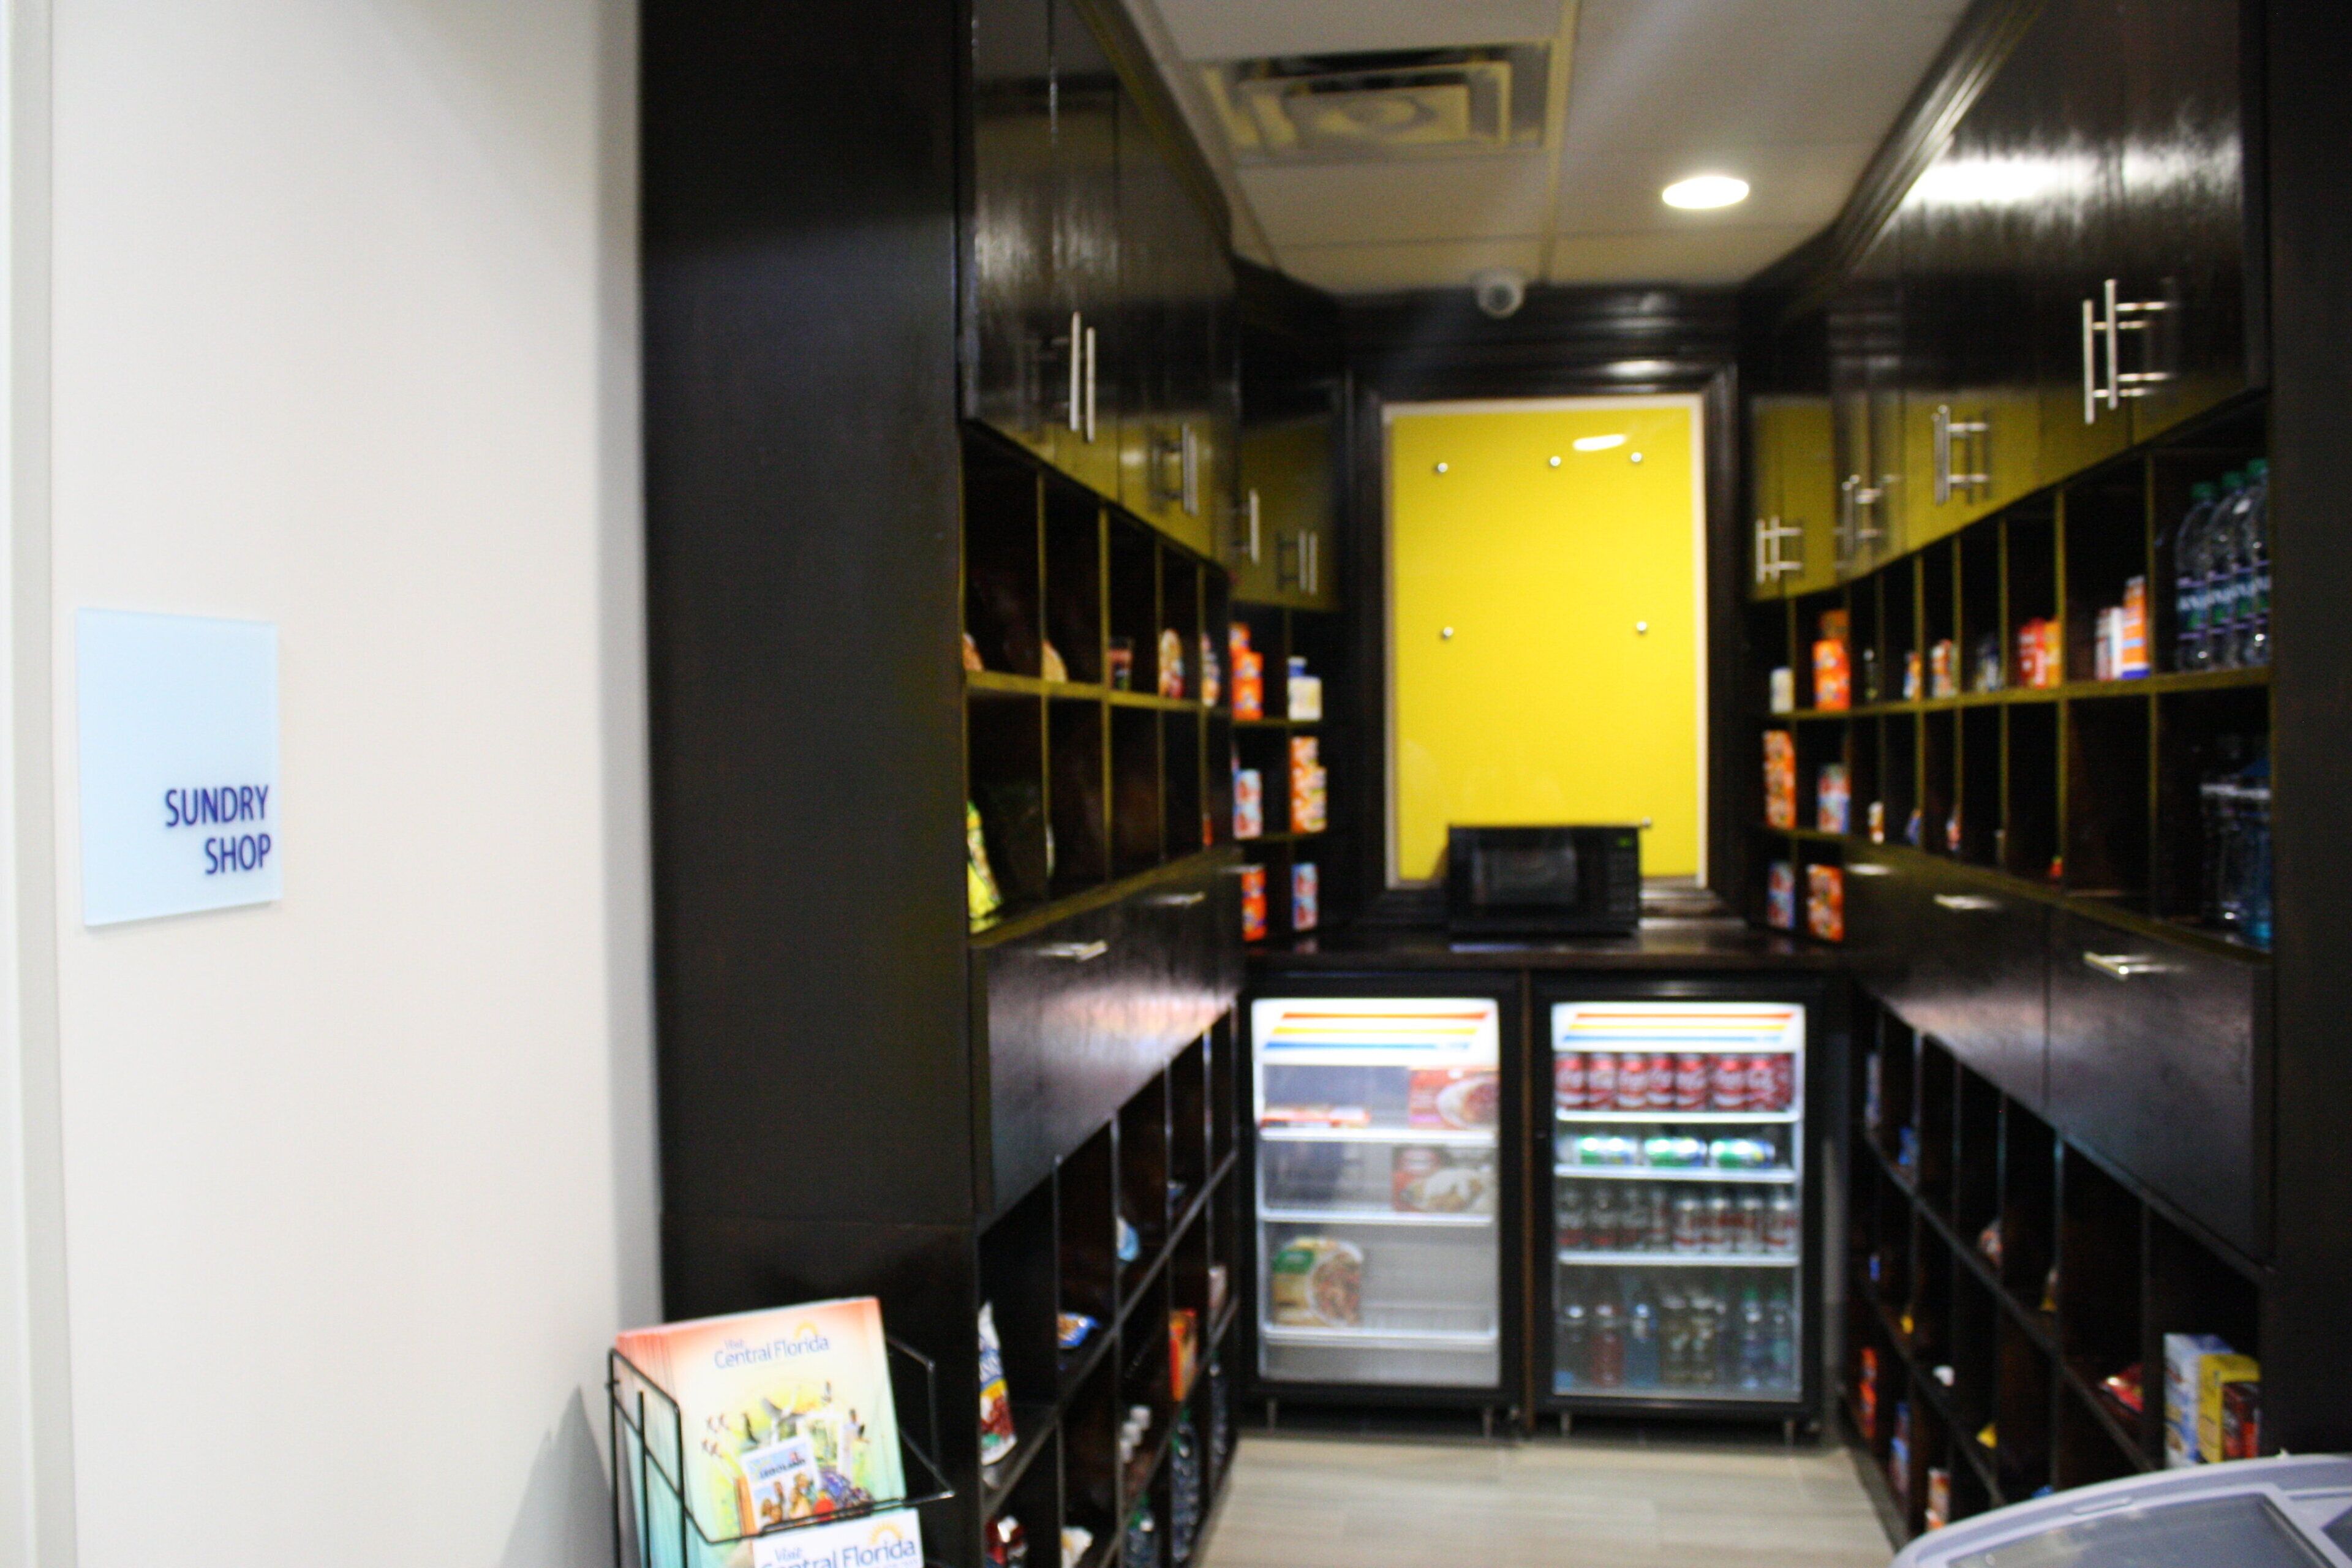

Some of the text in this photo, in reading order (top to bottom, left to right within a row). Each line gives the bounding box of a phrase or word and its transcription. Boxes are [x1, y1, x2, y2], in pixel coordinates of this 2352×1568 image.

[164, 785, 268, 828] SUNDRY
[204, 832, 271, 875] SHOP
[714, 1334, 830, 1369] Central Florida
[775, 1547, 803, 1561] Visit
[842, 1539, 916, 1568] Florida
